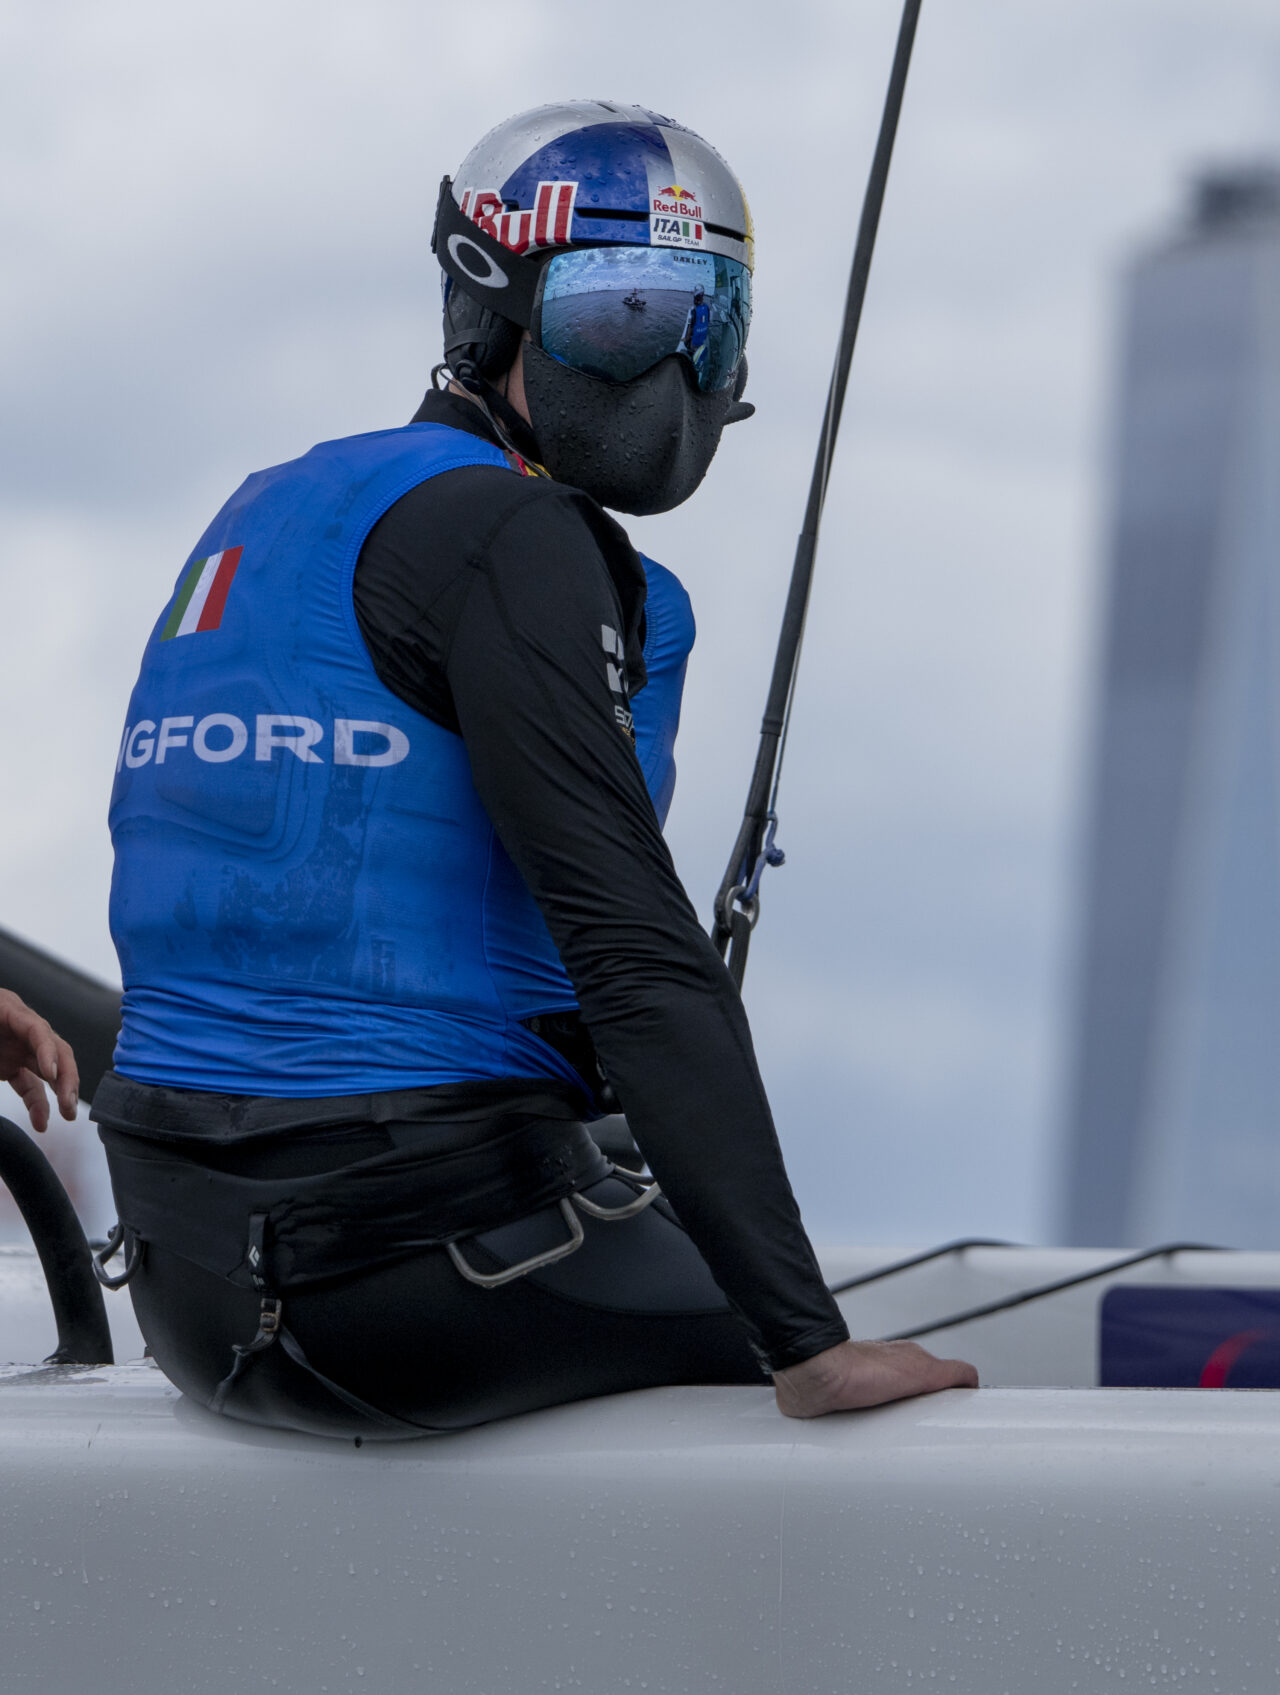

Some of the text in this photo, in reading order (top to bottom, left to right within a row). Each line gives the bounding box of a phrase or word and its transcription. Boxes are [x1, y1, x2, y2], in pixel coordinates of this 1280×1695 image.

[653, 199, 702, 218] Red Bull
[471, 184, 575, 255] Bull
[653, 218, 680, 235] ITA
[684, 238, 700, 246] TEAM
